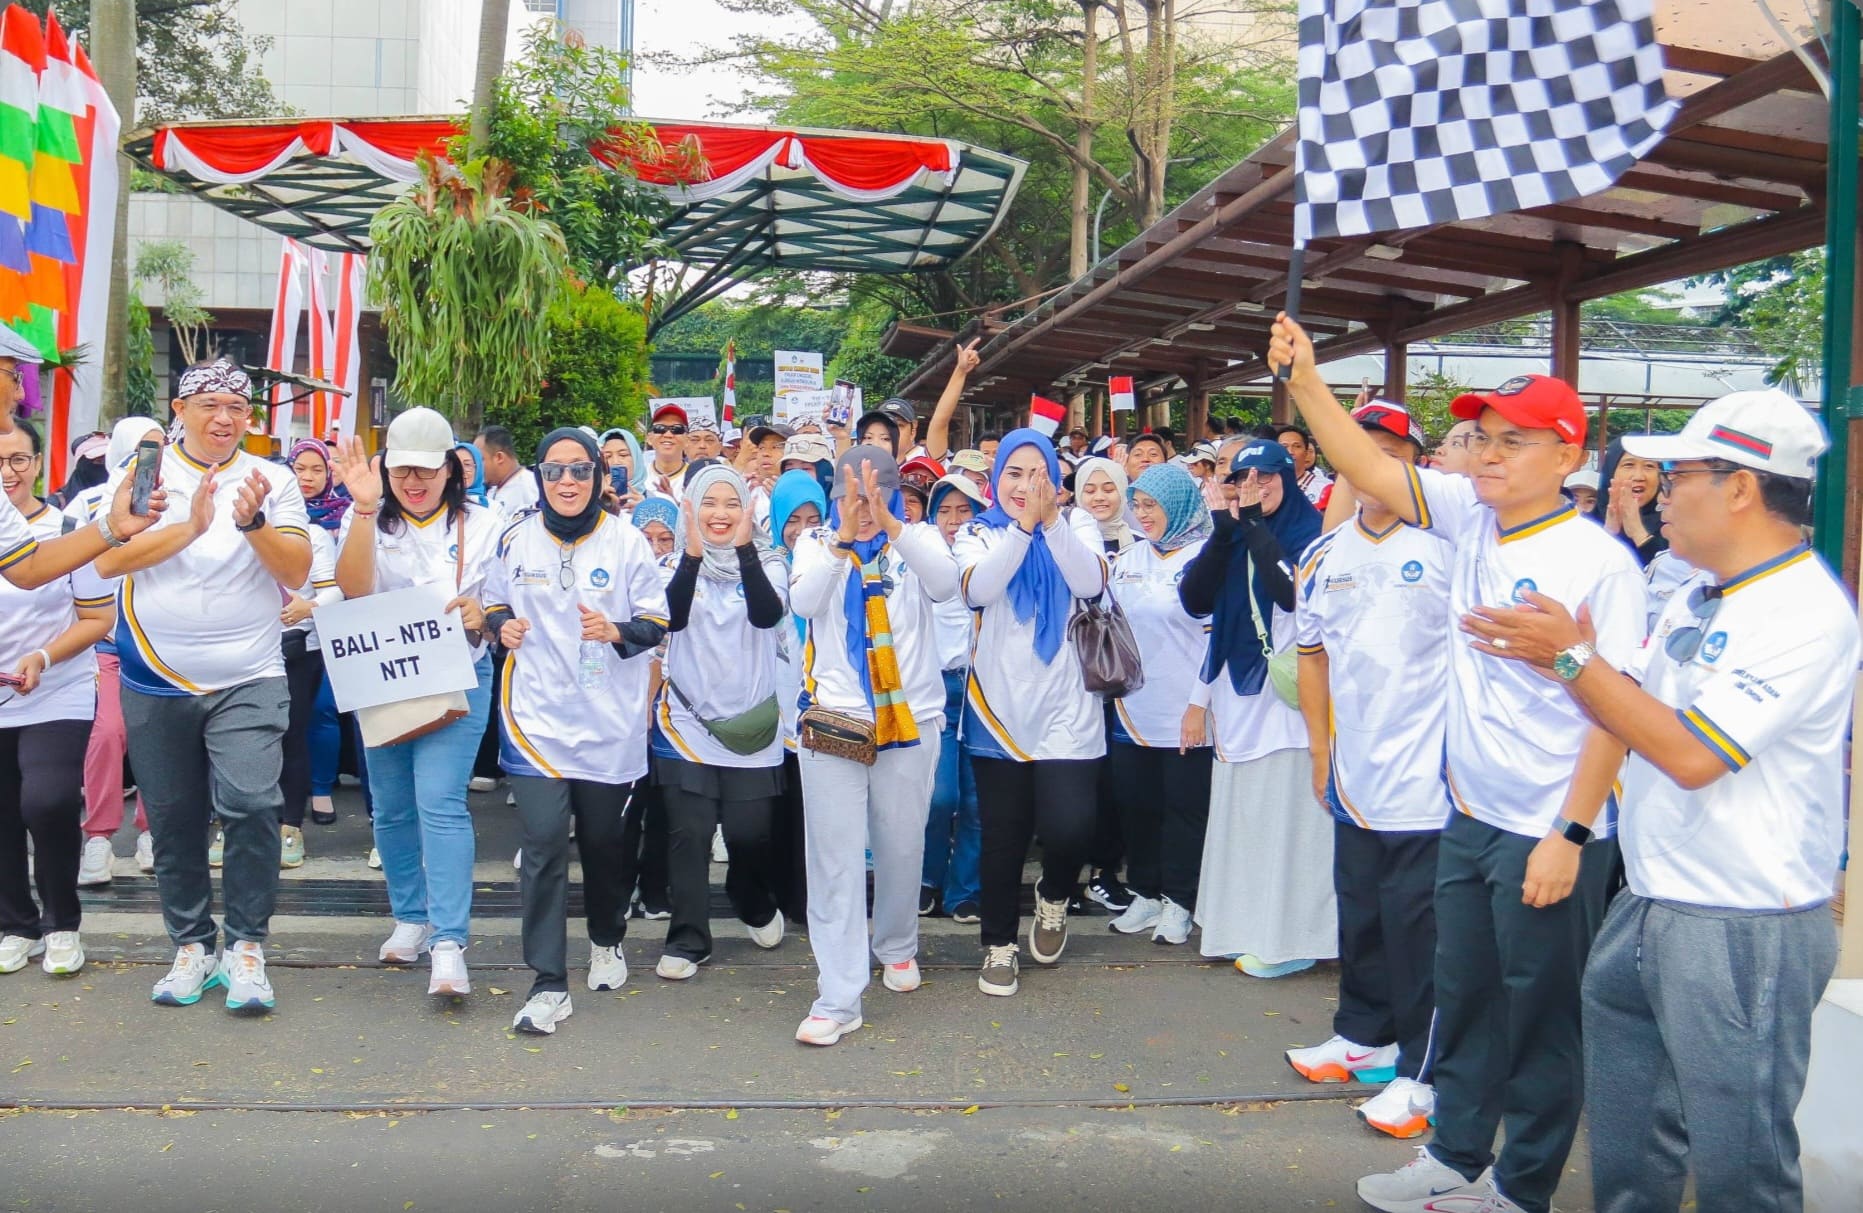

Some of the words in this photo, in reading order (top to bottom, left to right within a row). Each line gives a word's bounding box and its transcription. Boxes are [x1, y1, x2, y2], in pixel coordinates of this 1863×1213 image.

[331, 631, 380, 658] BALI
[400, 619, 441, 644] NTB
[380, 655, 420, 681] NTT
